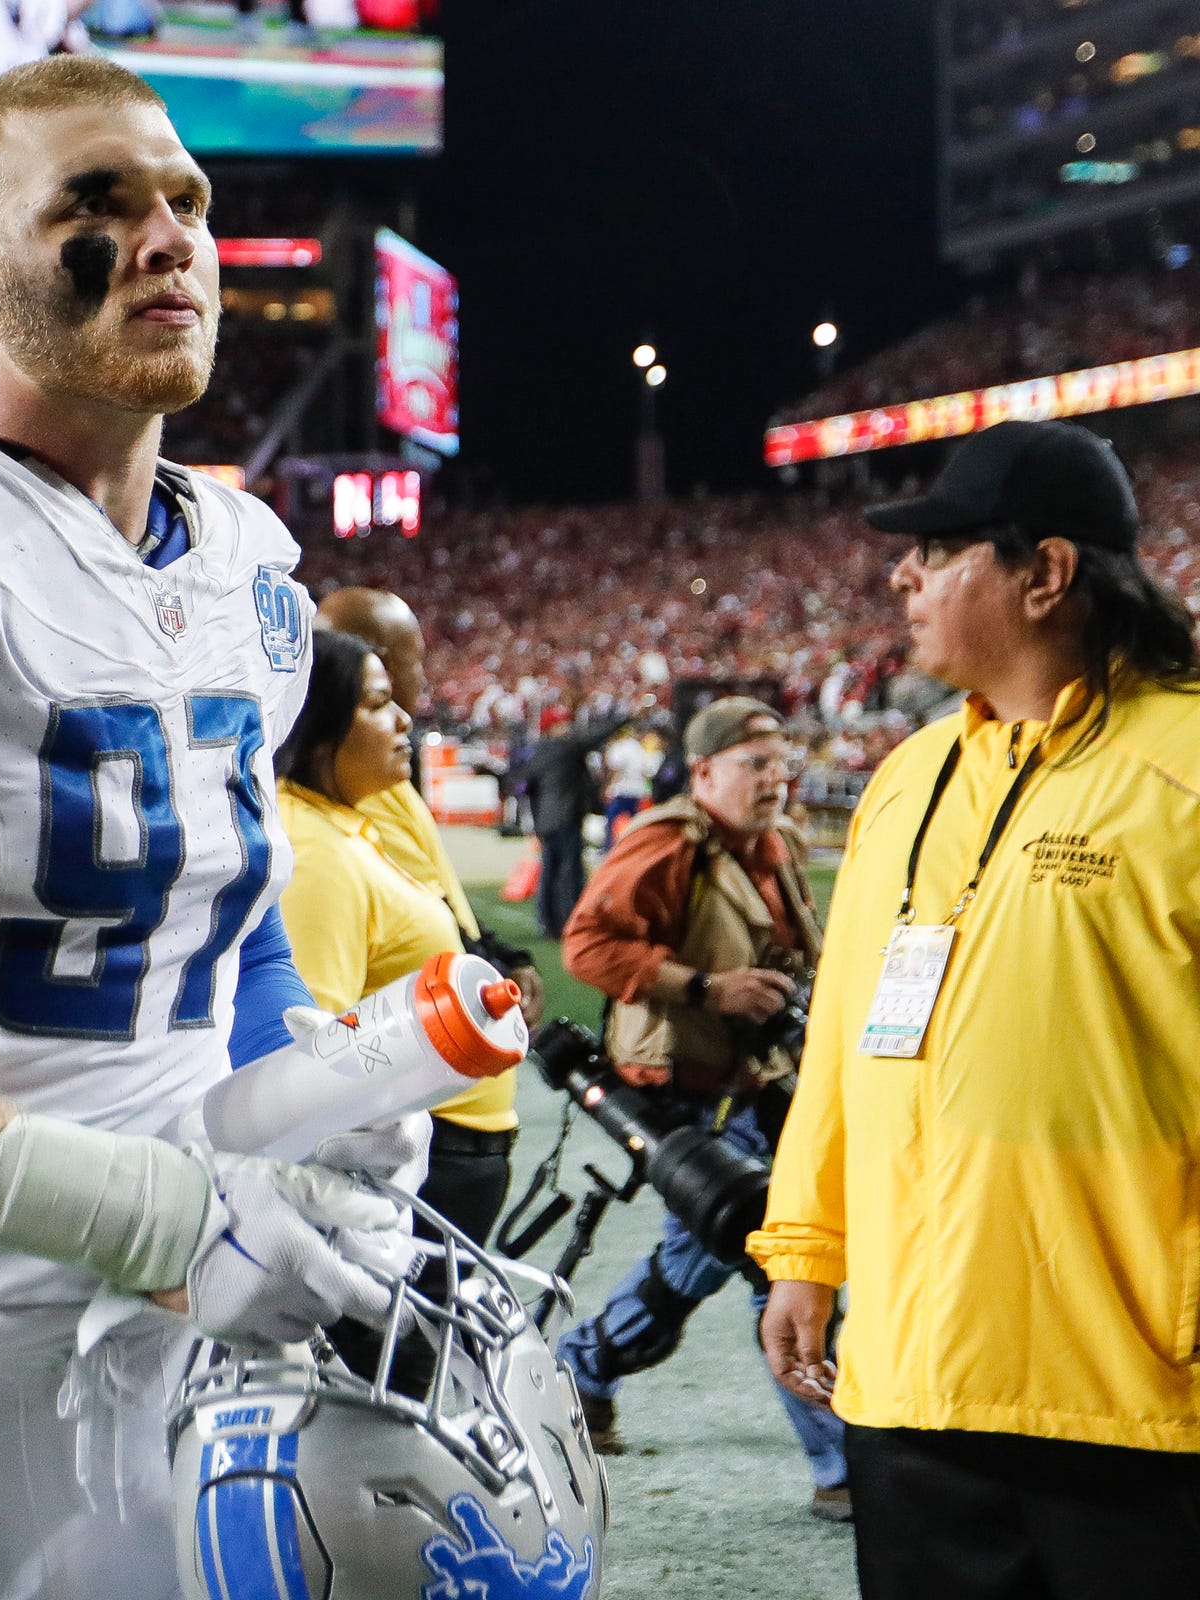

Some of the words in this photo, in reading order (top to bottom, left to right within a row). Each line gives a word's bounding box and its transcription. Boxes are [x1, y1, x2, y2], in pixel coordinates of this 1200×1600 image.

[161, 608, 183, 630] NFL
[256, 581, 299, 644] 90
[1036, 846, 1118, 867] UNIVERSAL
